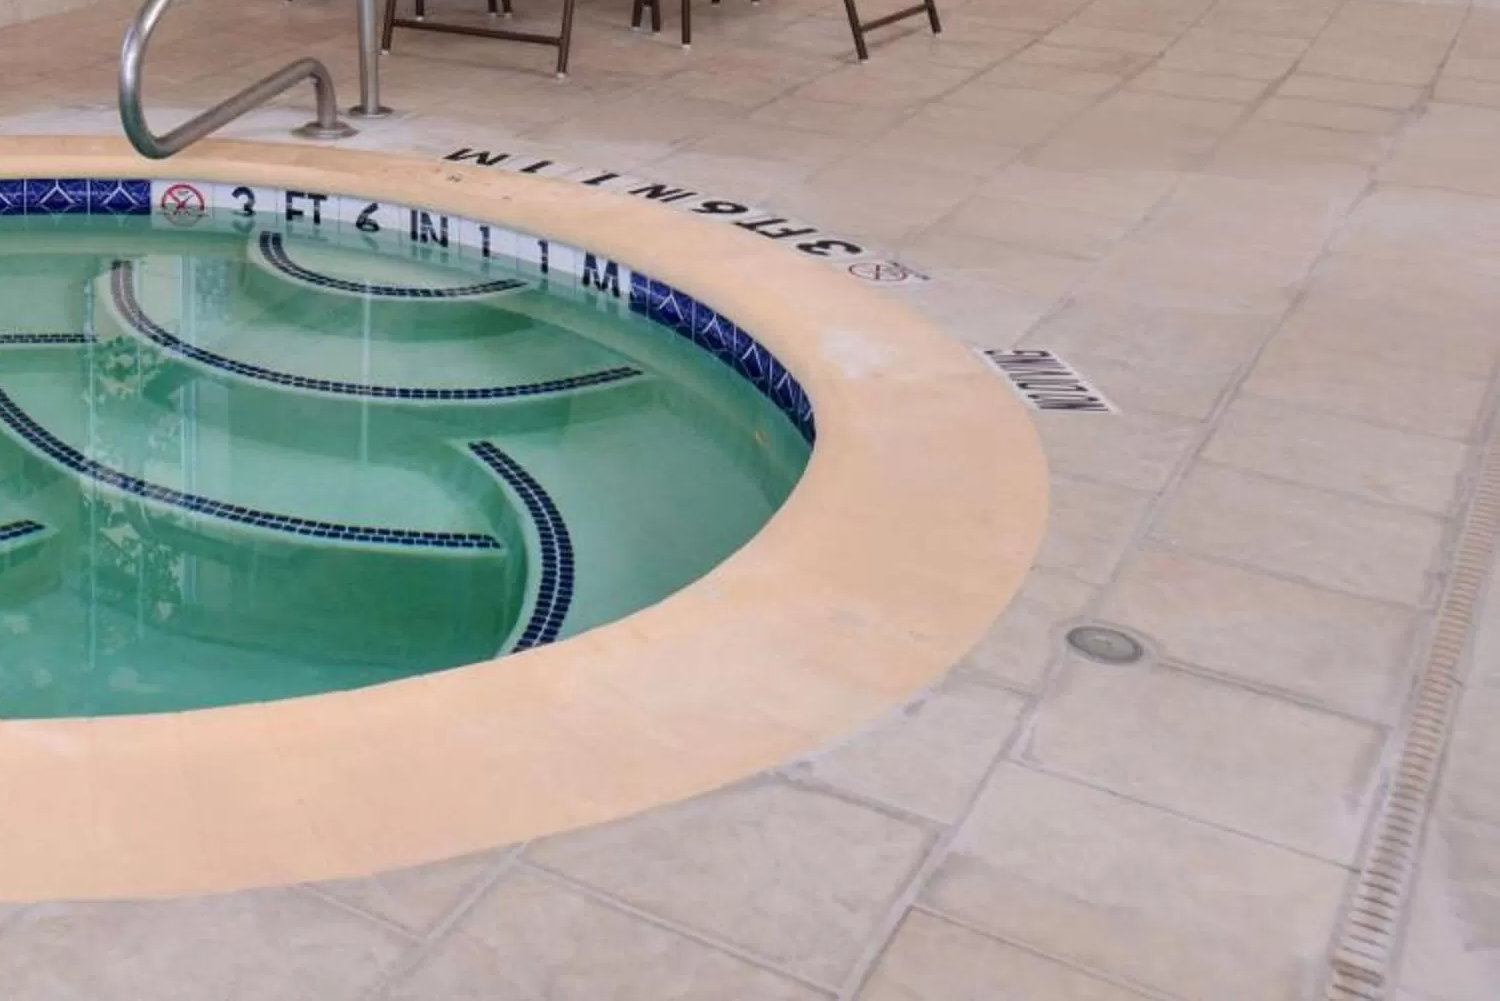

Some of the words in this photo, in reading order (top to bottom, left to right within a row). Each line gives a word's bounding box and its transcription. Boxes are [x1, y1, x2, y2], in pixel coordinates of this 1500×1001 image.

[231, 186, 256, 217] 3
[285, 190, 329, 225] FT
[355, 202, 380, 233] 6
[410, 209, 448, 248] IN
[582, 250, 620, 298] M
[796, 240, 863, 256] 3
